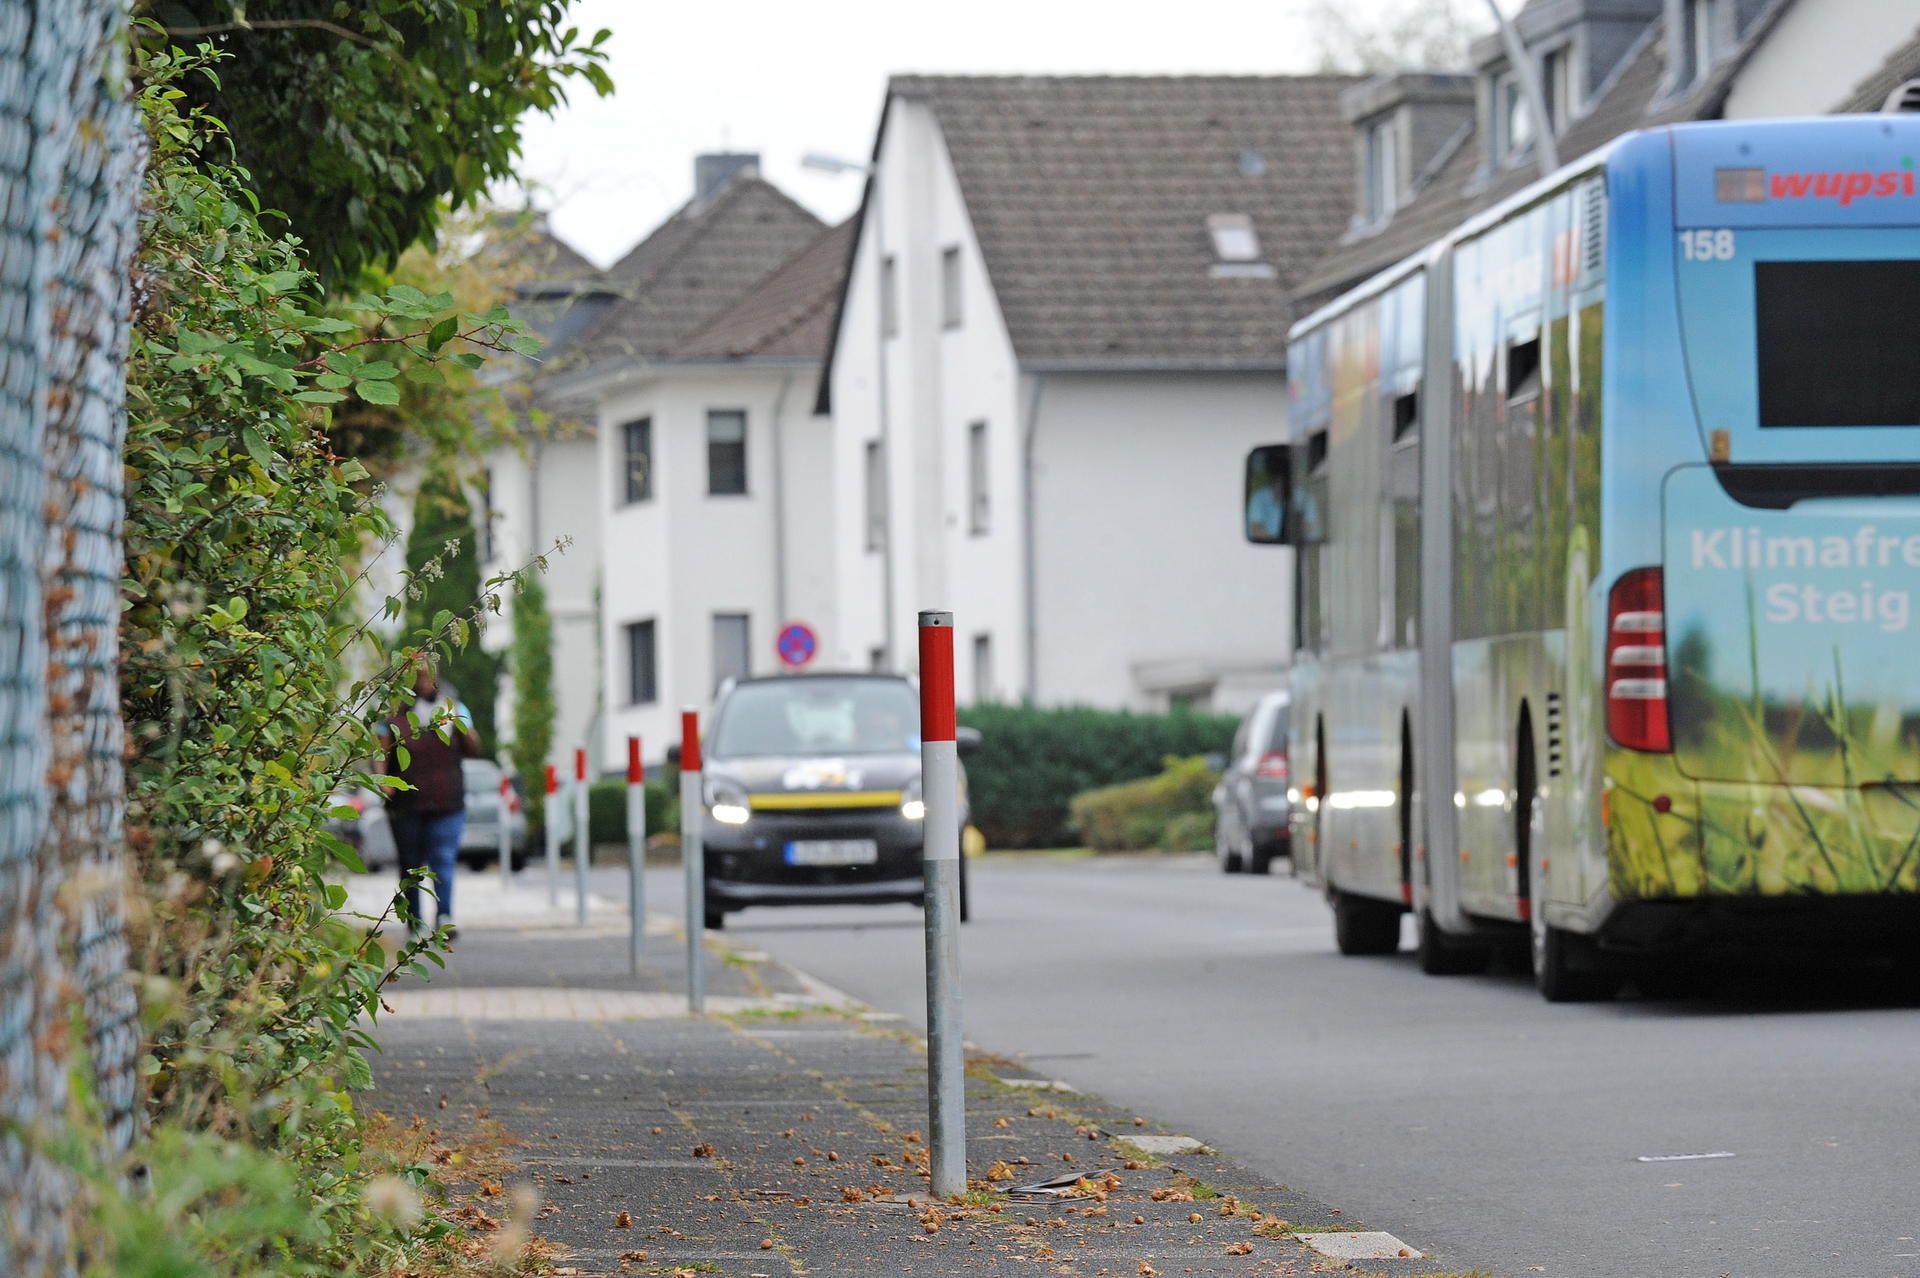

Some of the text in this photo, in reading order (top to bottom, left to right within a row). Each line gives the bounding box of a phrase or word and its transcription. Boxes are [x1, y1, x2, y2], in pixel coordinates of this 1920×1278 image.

[1770, 156, 1915, 207] wupsi
[1680, 229, 1735, 261] 158
[1766, 581, 1910, 632] Steig
